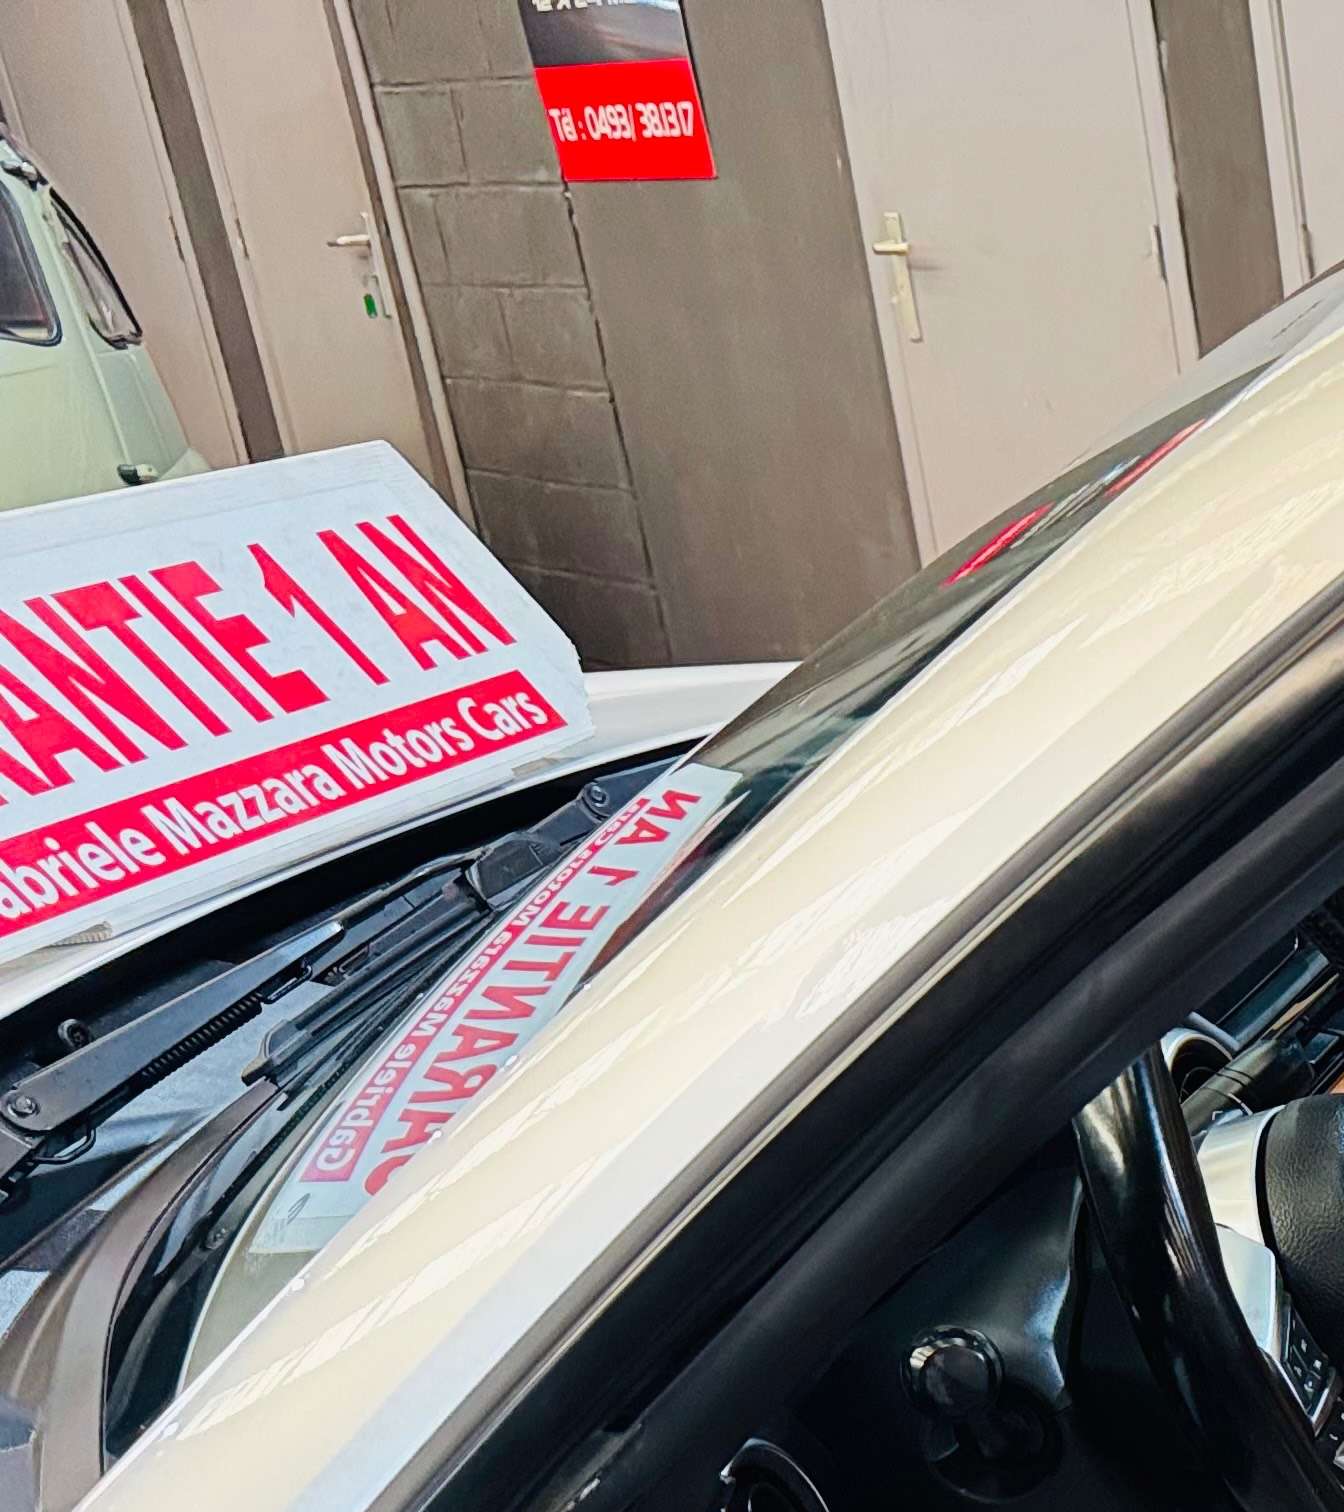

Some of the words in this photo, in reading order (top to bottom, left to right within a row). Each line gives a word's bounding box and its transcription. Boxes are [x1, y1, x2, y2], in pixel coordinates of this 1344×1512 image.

[0, 560, 331, 806] ANTIE
[247, 543, 391, 686] 1
[316, 514, 518, 671] AN
[0, 821, 167, 919] abriele
[141, 764, 338, 857] Mazzara
[321, 714, 475, 791] Motors
[458, 688, 549, 744] Cars
